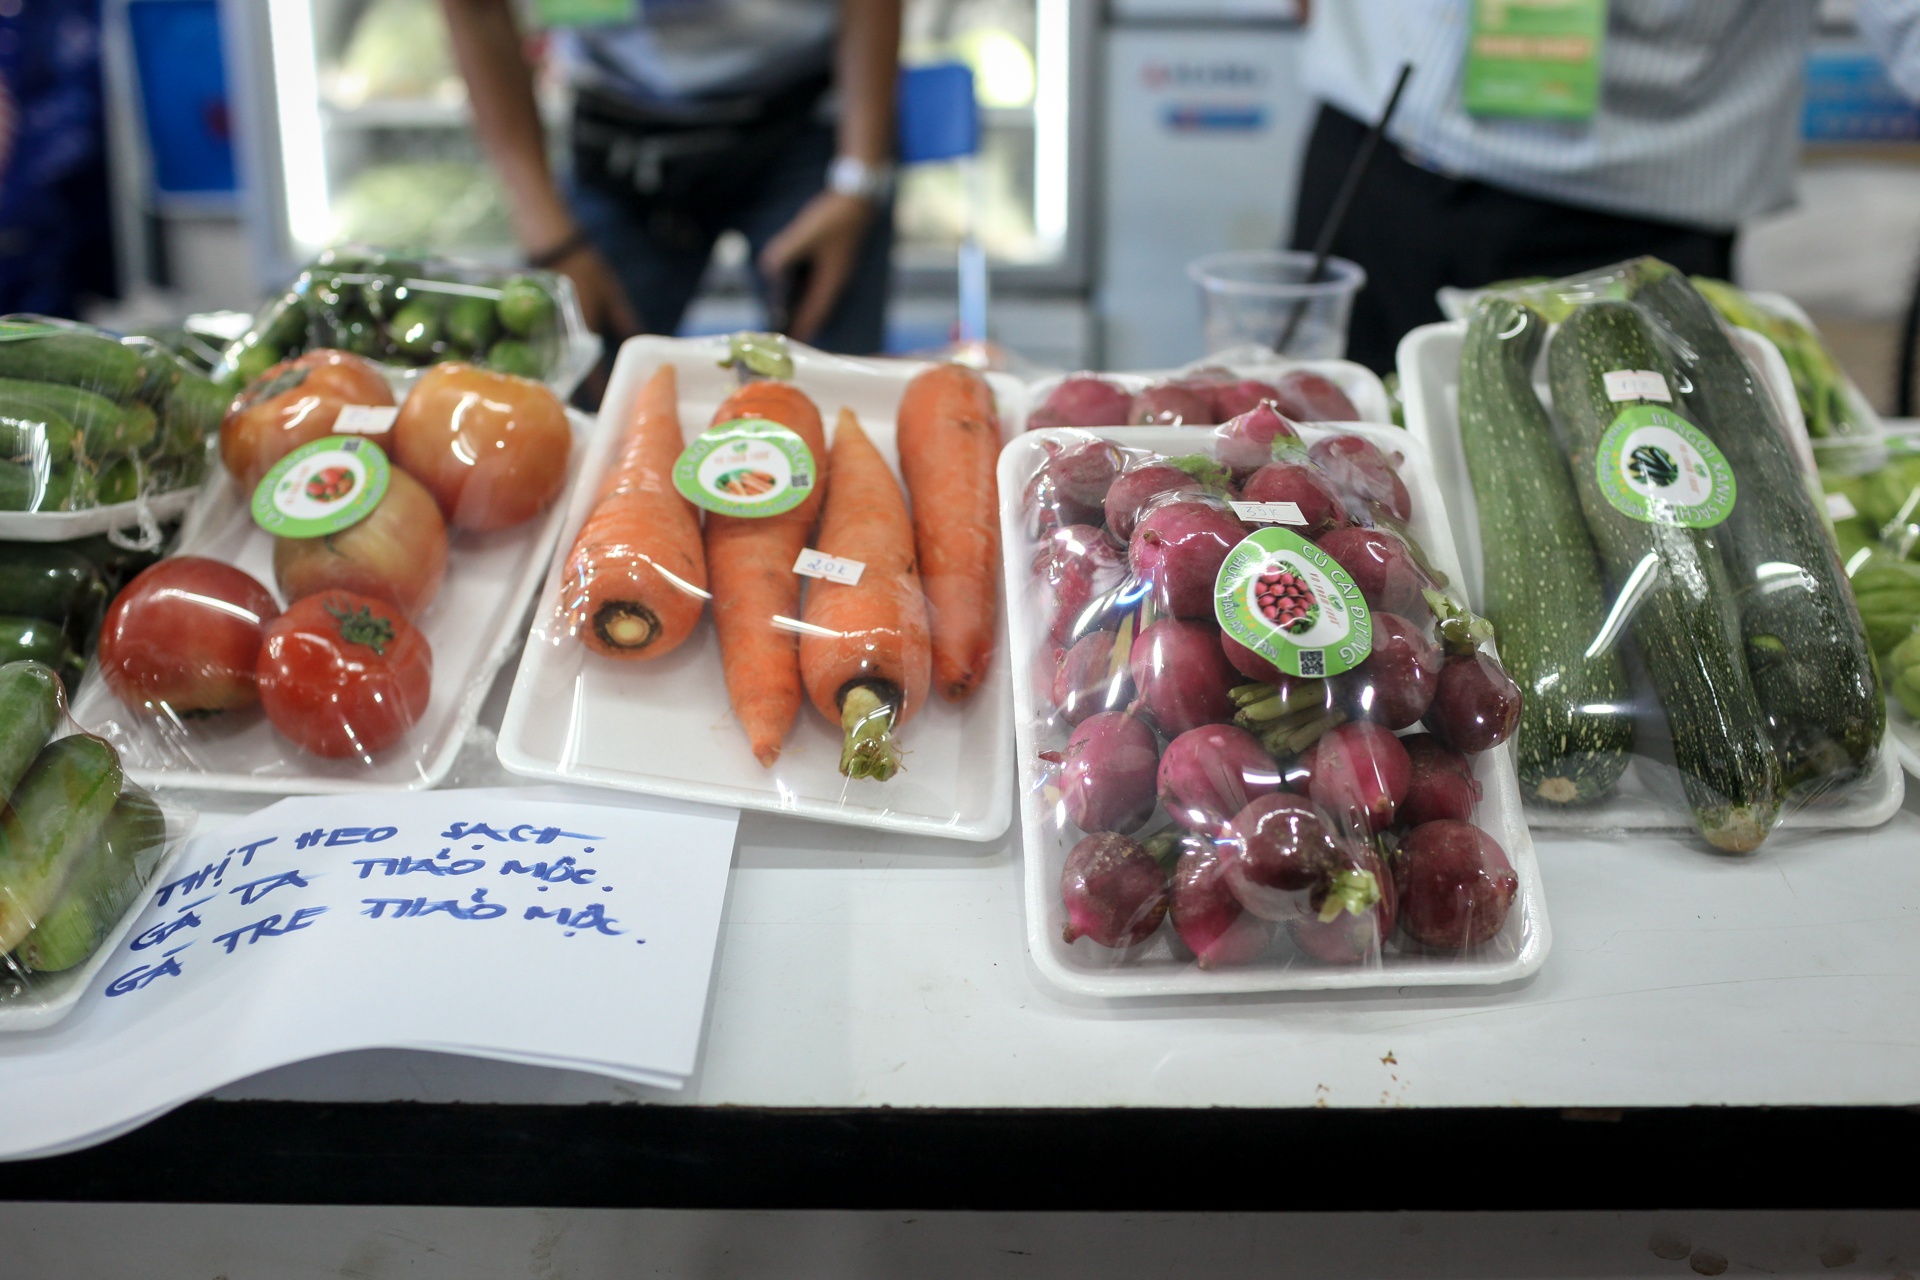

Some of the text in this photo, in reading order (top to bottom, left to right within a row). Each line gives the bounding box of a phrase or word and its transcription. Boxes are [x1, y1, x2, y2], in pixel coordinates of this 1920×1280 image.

[1302, 544, 1329, 568] CỦ
[1330, 569, 1360, 600] CẢI
[1229, 620, 1247, 635] AN
[156, 836, 278, 907] THỊT
[295, 826, 398, 850] HEO
[229, 869, 324, 905] TA
[212, 905, 331, 954] TRE
